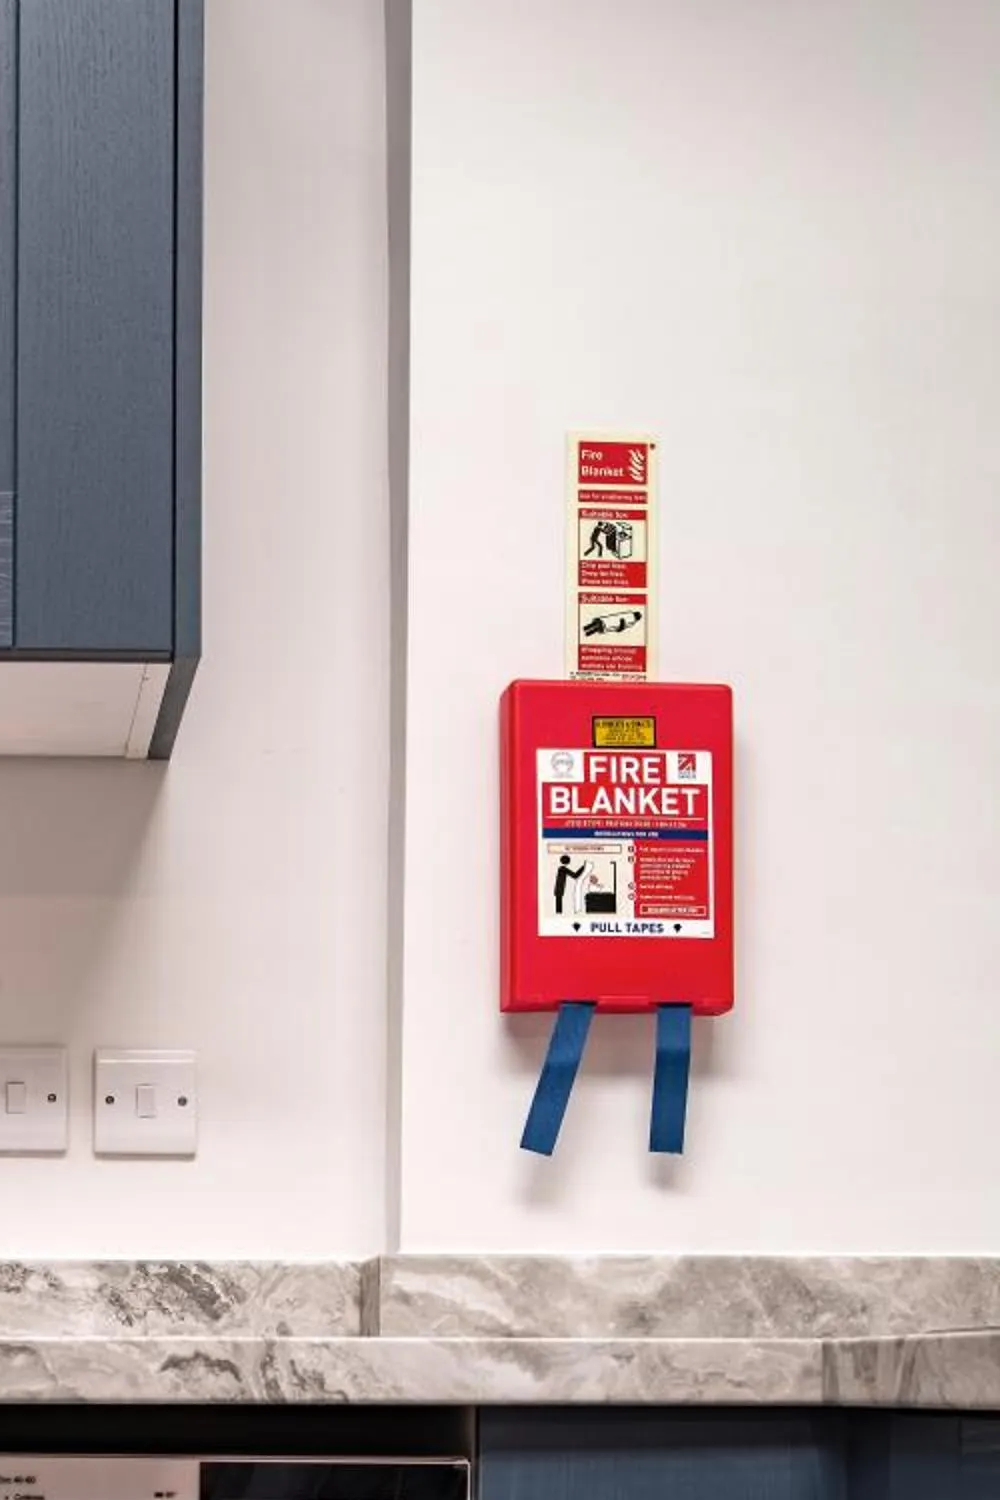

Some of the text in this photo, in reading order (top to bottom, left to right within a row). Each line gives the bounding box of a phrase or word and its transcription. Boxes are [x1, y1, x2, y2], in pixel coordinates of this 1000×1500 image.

[581, 449, 602, 461] Fire
[581, 466, 624, 477] Blanket
[590, 756, 661, 784] FIRE
[551, 787, 700, 815] BLANKET
[590, 922, 664, 933] PULL TAPES
